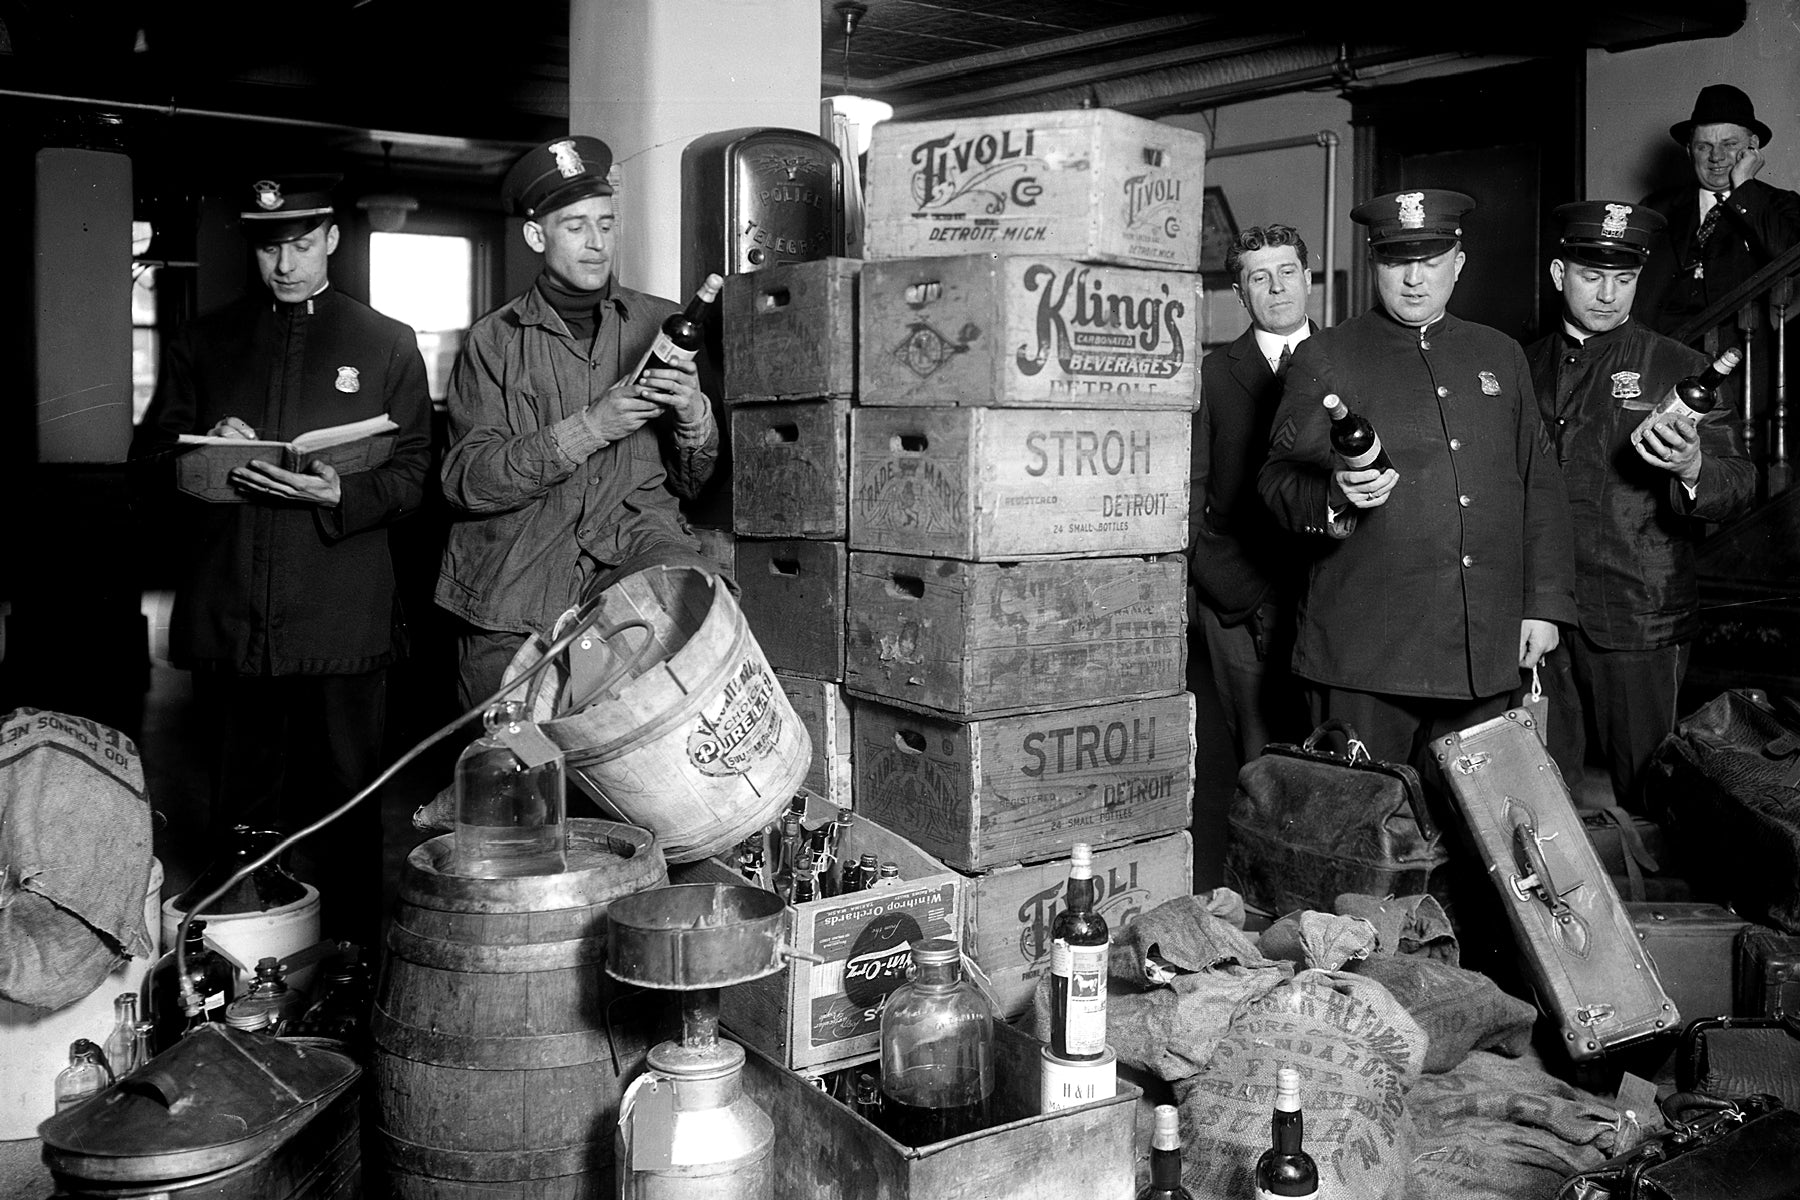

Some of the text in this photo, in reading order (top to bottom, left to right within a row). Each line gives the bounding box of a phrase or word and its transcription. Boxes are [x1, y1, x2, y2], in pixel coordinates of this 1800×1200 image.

[759, 186, 824, 208] POLICE
[1016, 264, 1185, 376] Kling's
[1076, 333, 1134, 347] CARBONATED
[1069, 353, 1175, 376] BEVERAGES
[1025, 429, 1151, 477] STROH
[859, 461, 895, 520] TRADE
[924, 460, 965, 524] MARK
[1102, 493, 1169, 518] DETROIT
[1053, 521, 1129, 534] 24 SMALL BOTTLES
[724, 681, 761, 731] CHOICE
[37, 716, 98, 752] POUNDS
[695, 714, 755, 764] PURE
[1020, 716, 1156, 778] STROH
[1103, 776, 1174, 808] DETROIT
[1067, 816, 1094, 828] SMALL
[824, 893, 942, 926] Winthrop Orchards
[1018, 861, 1138, 963] TIOLI
